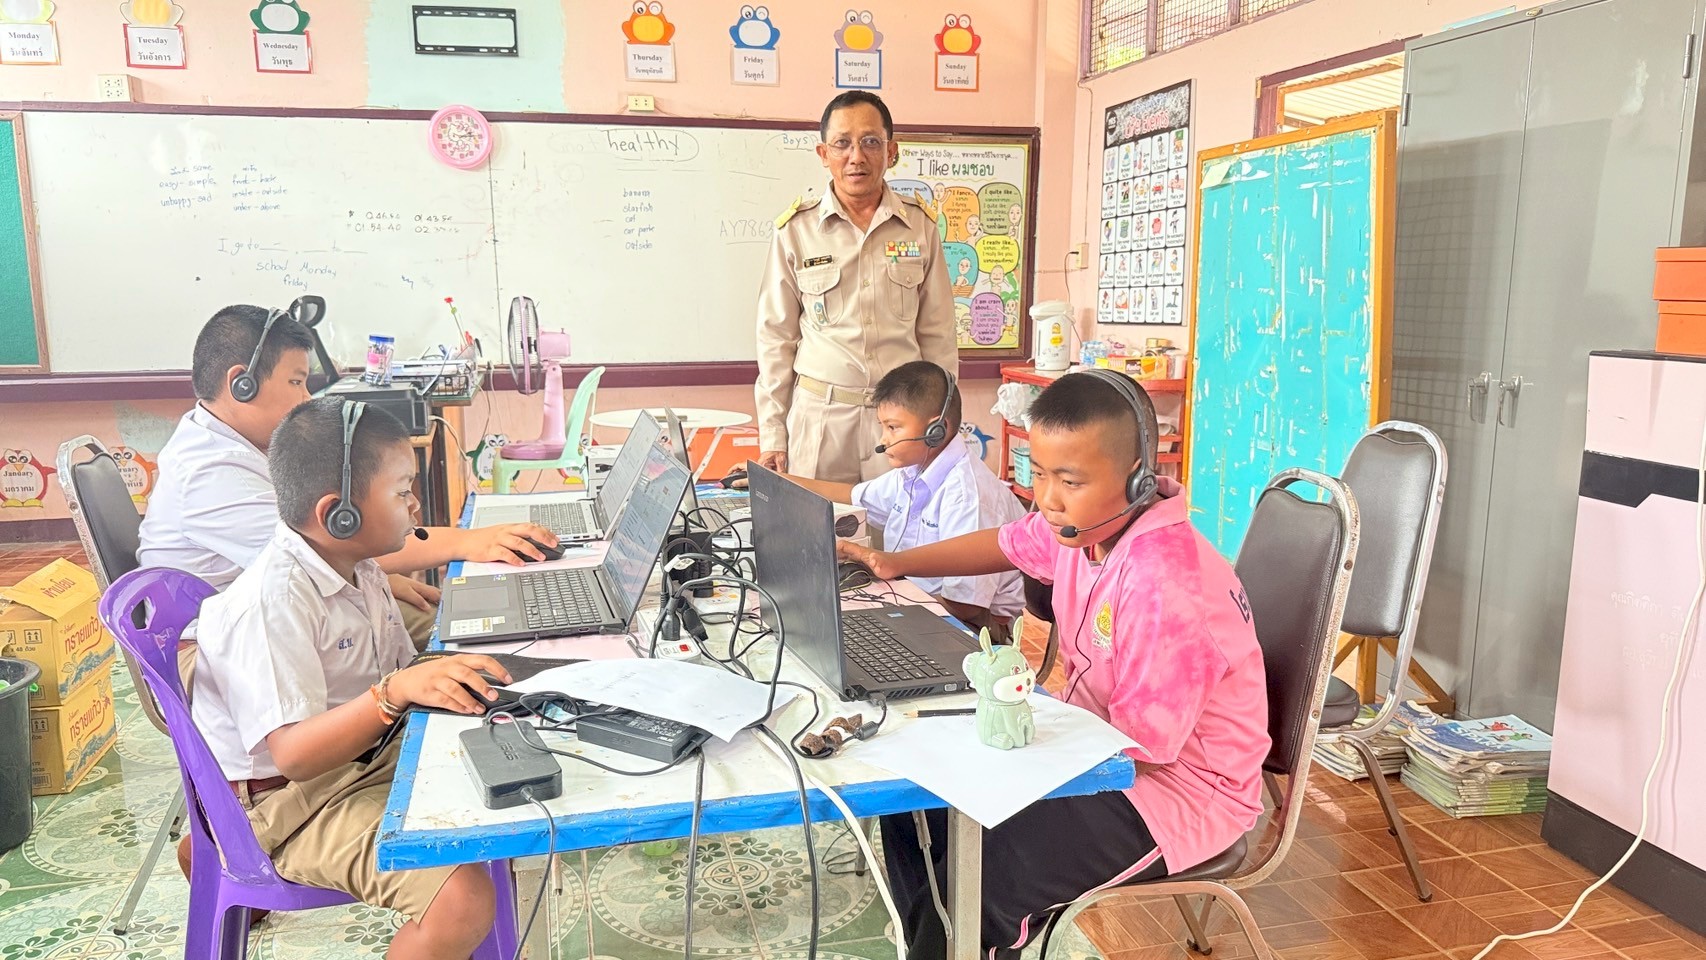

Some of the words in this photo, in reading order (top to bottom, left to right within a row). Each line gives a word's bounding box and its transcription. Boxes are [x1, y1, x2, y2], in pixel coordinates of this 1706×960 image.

[8, 32, 40, 41] Monday
[137, 36, 168, 46] Tuesday
[263, 42, 298, 51] Wednesday
[10, 47, 43, 57] วันจันทร์
[138, 51, 171, 61] วันอังคาร
[272, 56, 293, 68] วันพุธ
[632, 54, 663, 63] Thursday
[743, 56, 764, 65] Friday
[843, 60, 871, 69] Saturday
[945, 63, 967, 71] Sunday
[607, 130, 680, 156] healthy
[901, 149, 919, 157] Other
[919, 150, 935, 158] Ways
[935, 150, 942, 158] to
[917, 158, 924, 176] I
[929, 159, 949, 176] like
[952, 163, 994, 176] ผมชอบ
[300, 260, 337, 278] Monday
[3, 470, 34, 478] January
